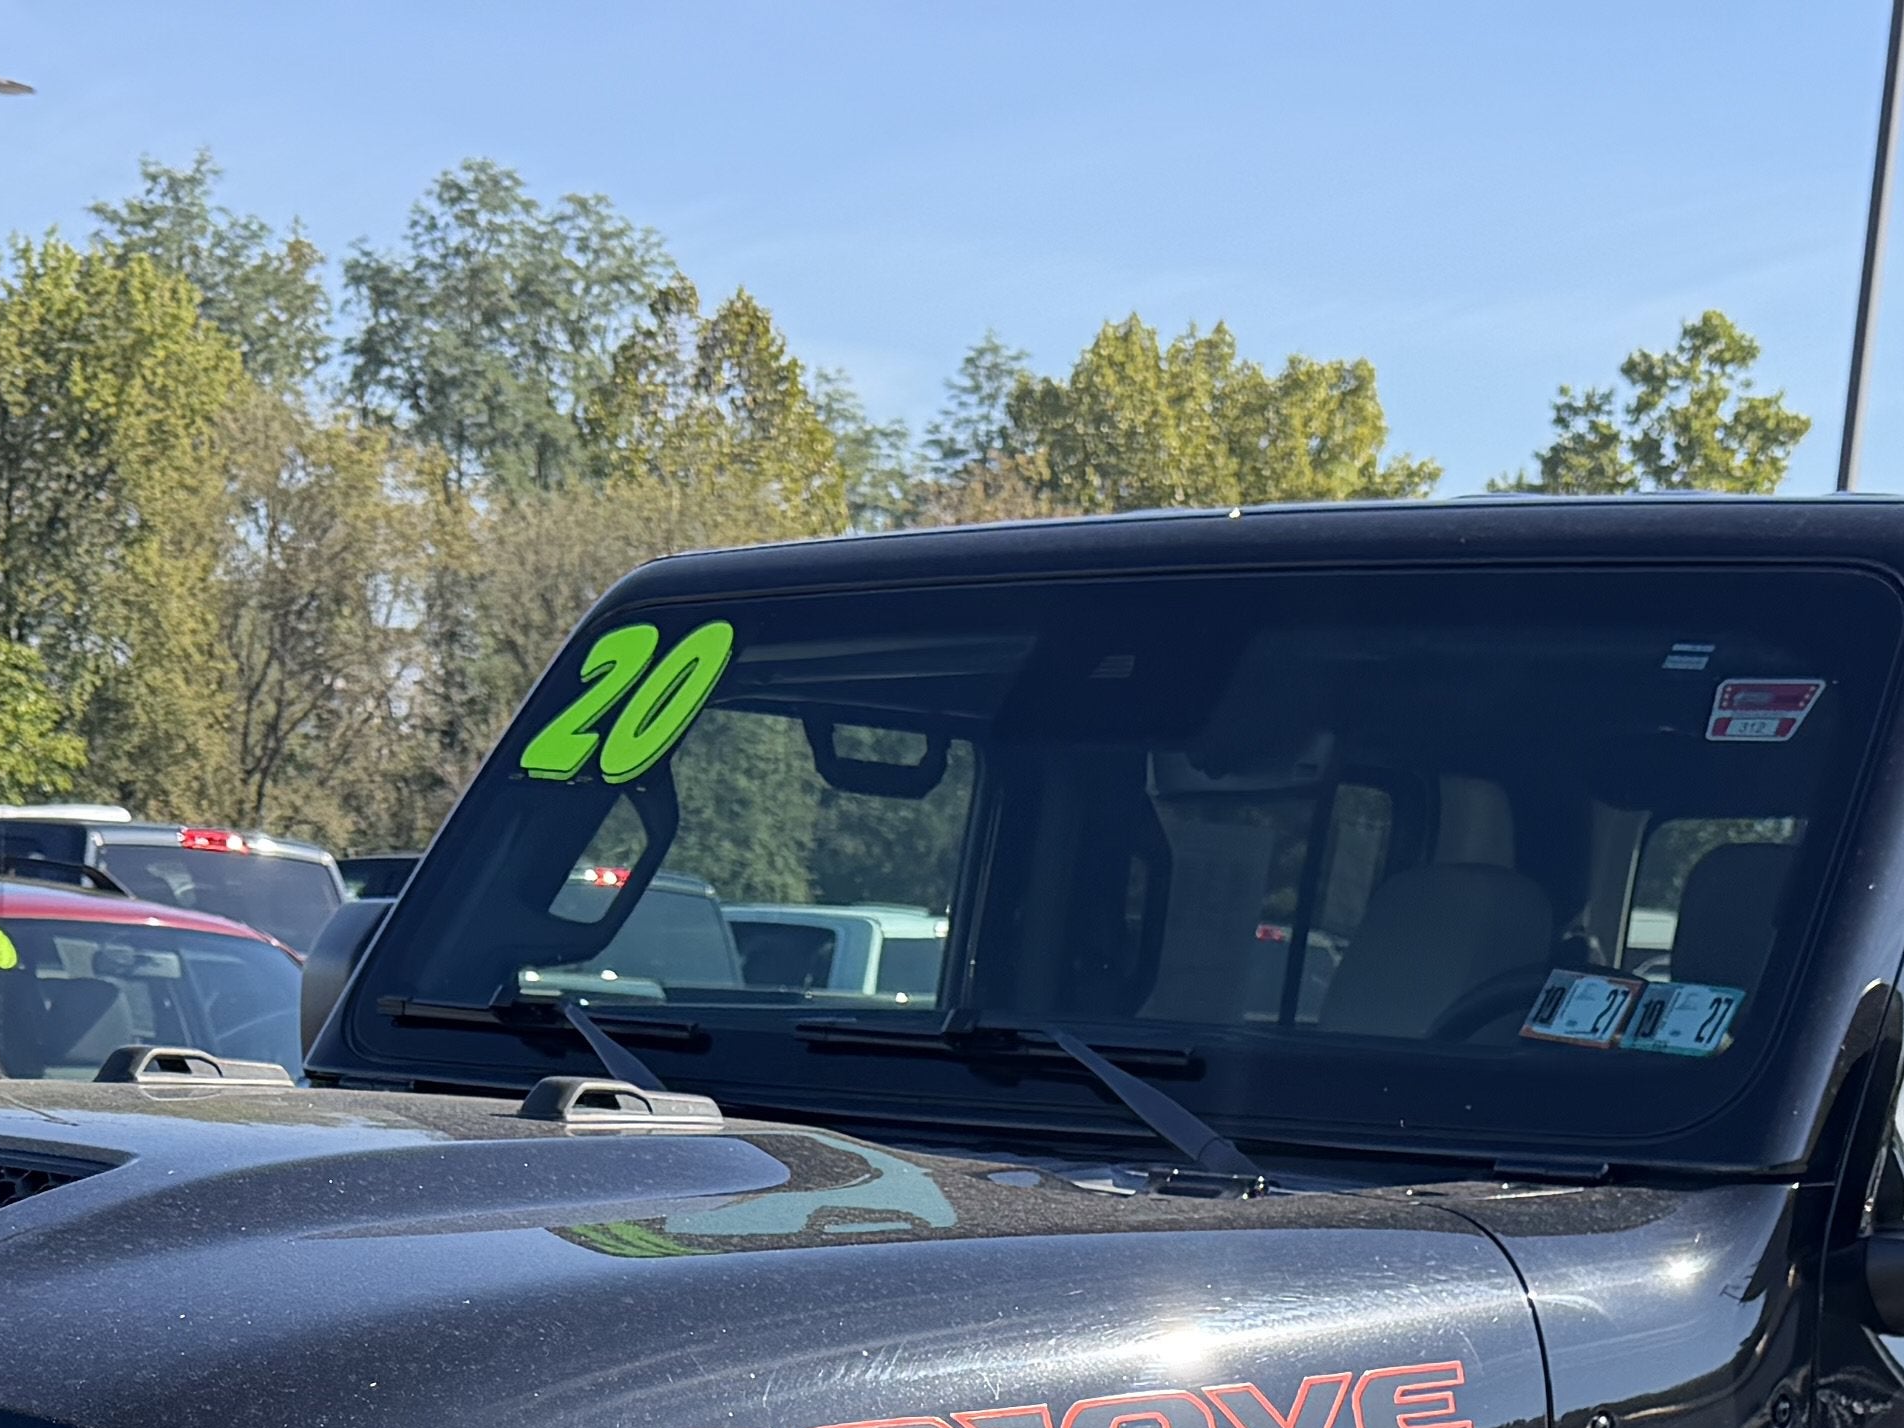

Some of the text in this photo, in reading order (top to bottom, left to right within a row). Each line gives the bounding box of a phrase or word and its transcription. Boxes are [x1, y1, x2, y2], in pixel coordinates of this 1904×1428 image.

[520, 621, 734, 784] 20
[1593, 989, 1630, 1036] 27
[1696, 997, 1734, 1044] 27
